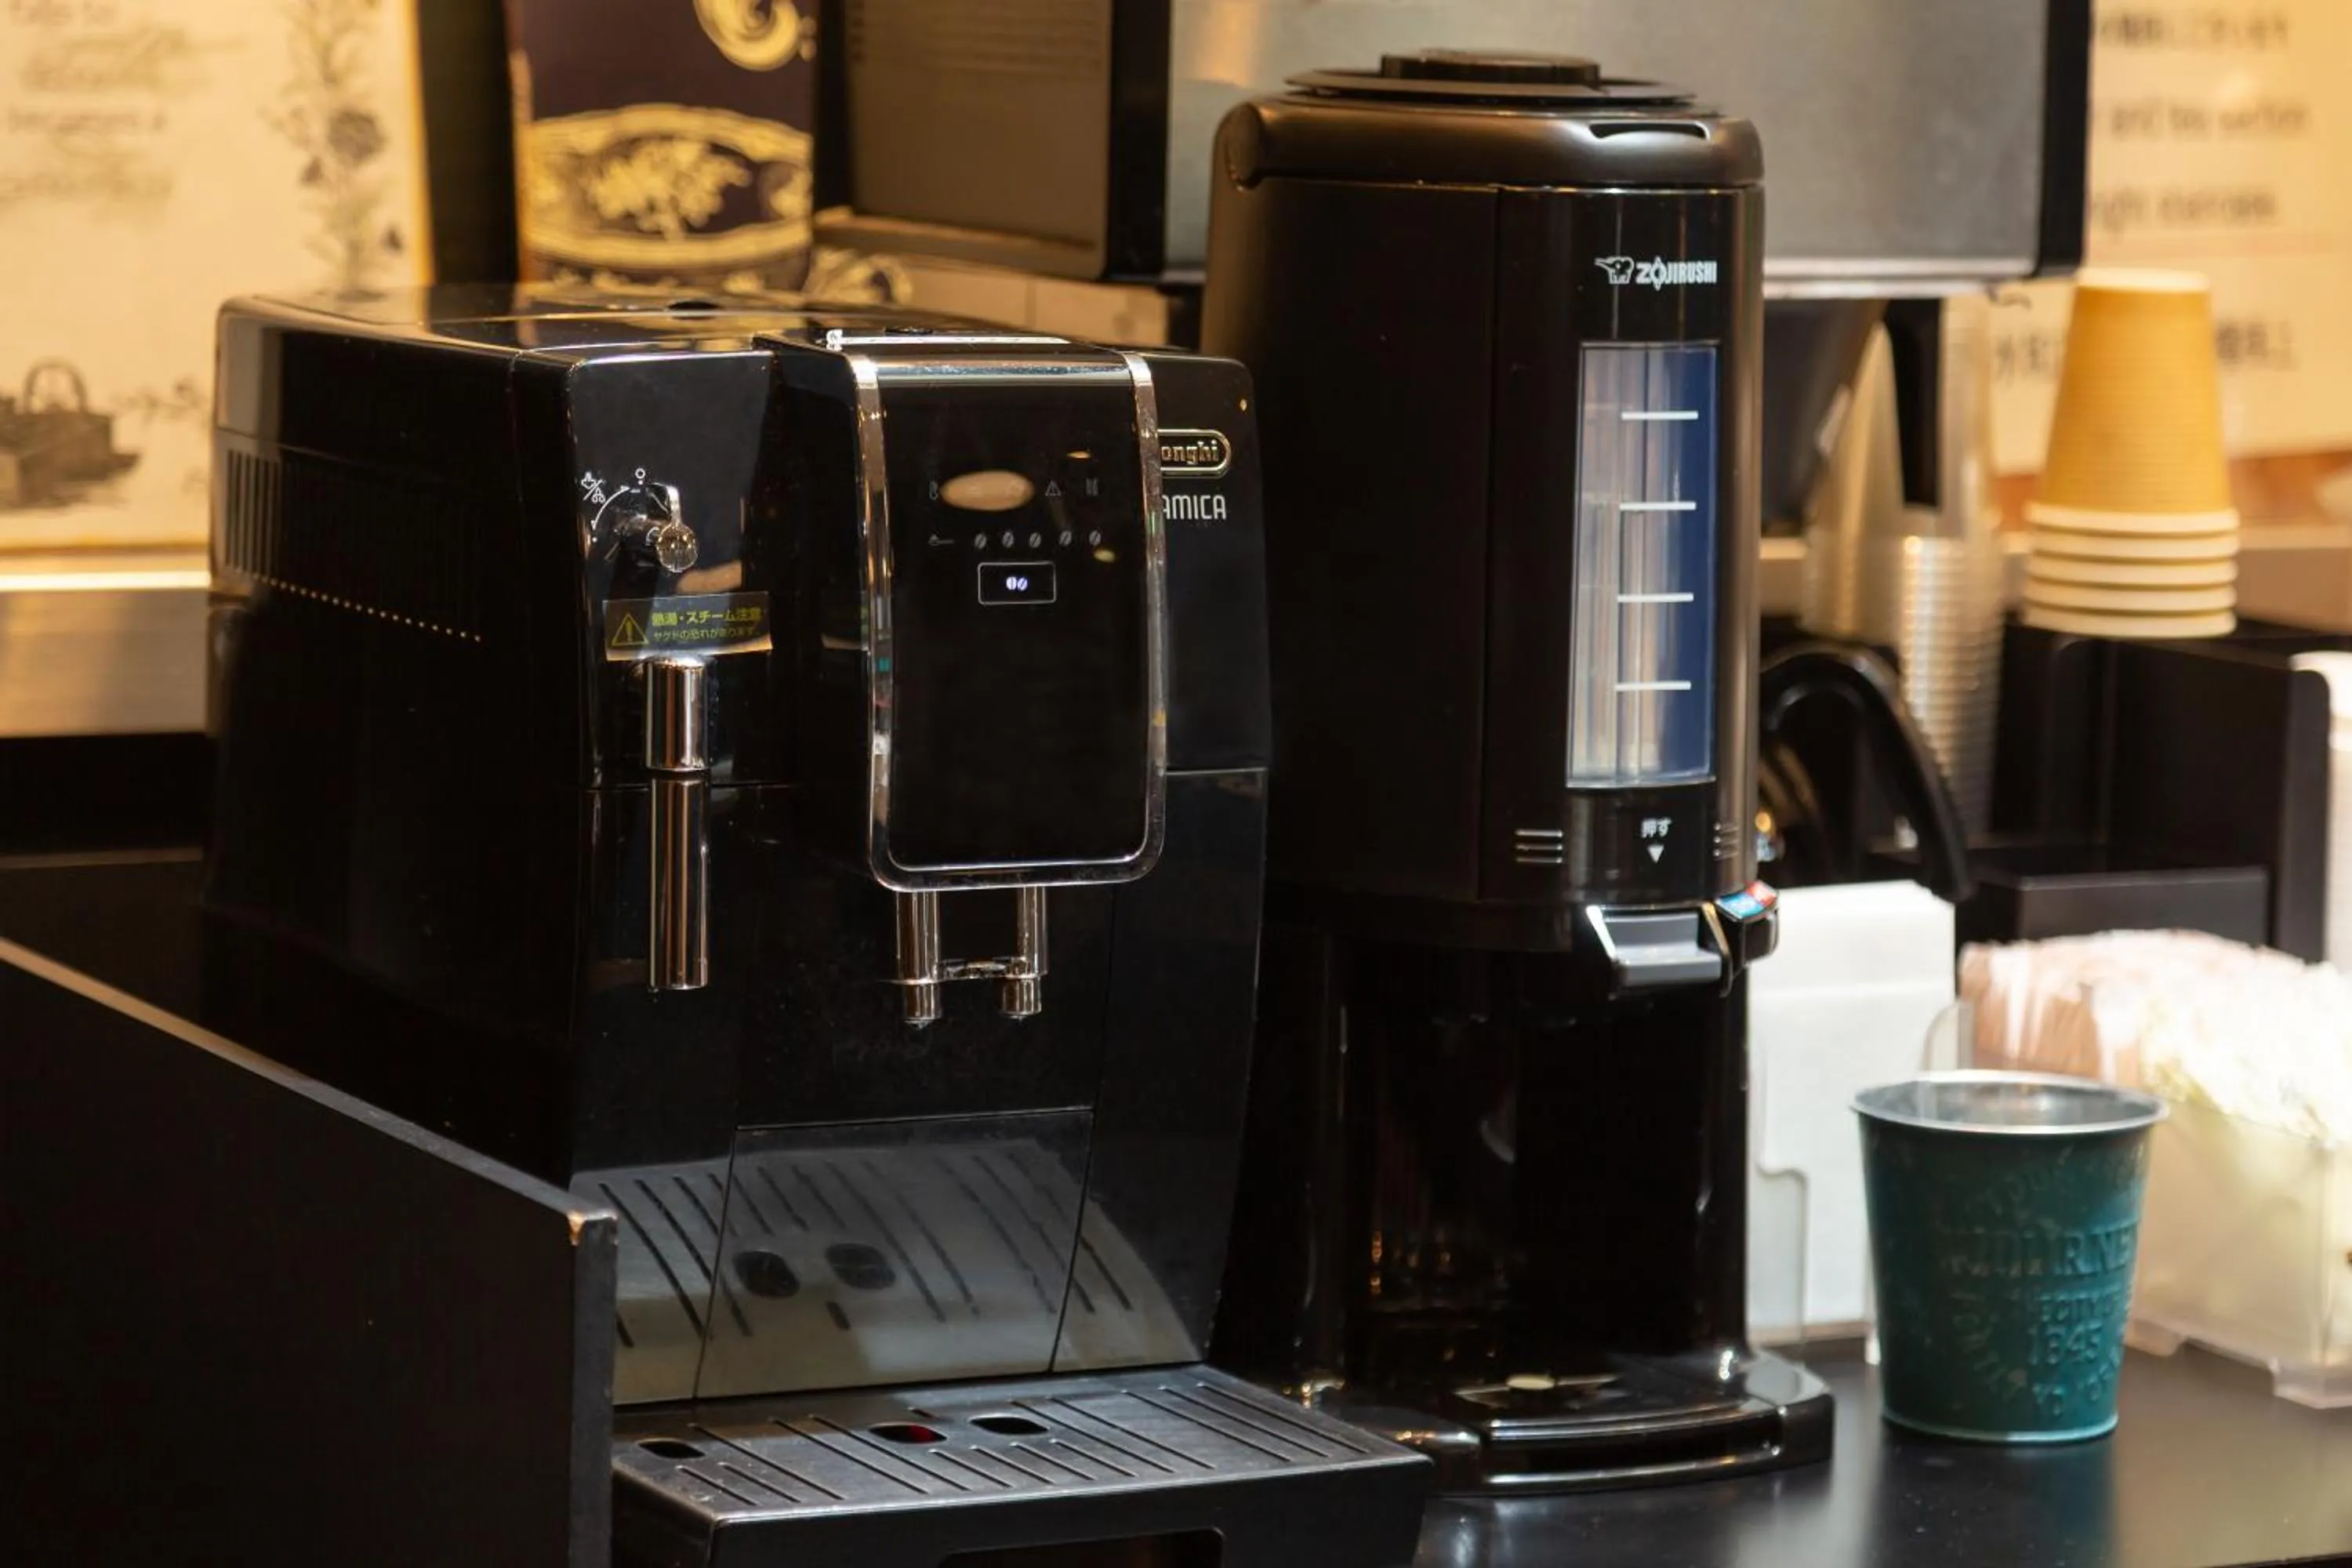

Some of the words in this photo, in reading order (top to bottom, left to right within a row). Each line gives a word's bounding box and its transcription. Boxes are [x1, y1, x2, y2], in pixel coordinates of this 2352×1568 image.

[1635, 256, 1717, 291] ZOJIRUSHI
[1161, 440, 1219, 464] onghi
[1162, 495, 1227, 520] AMICA
